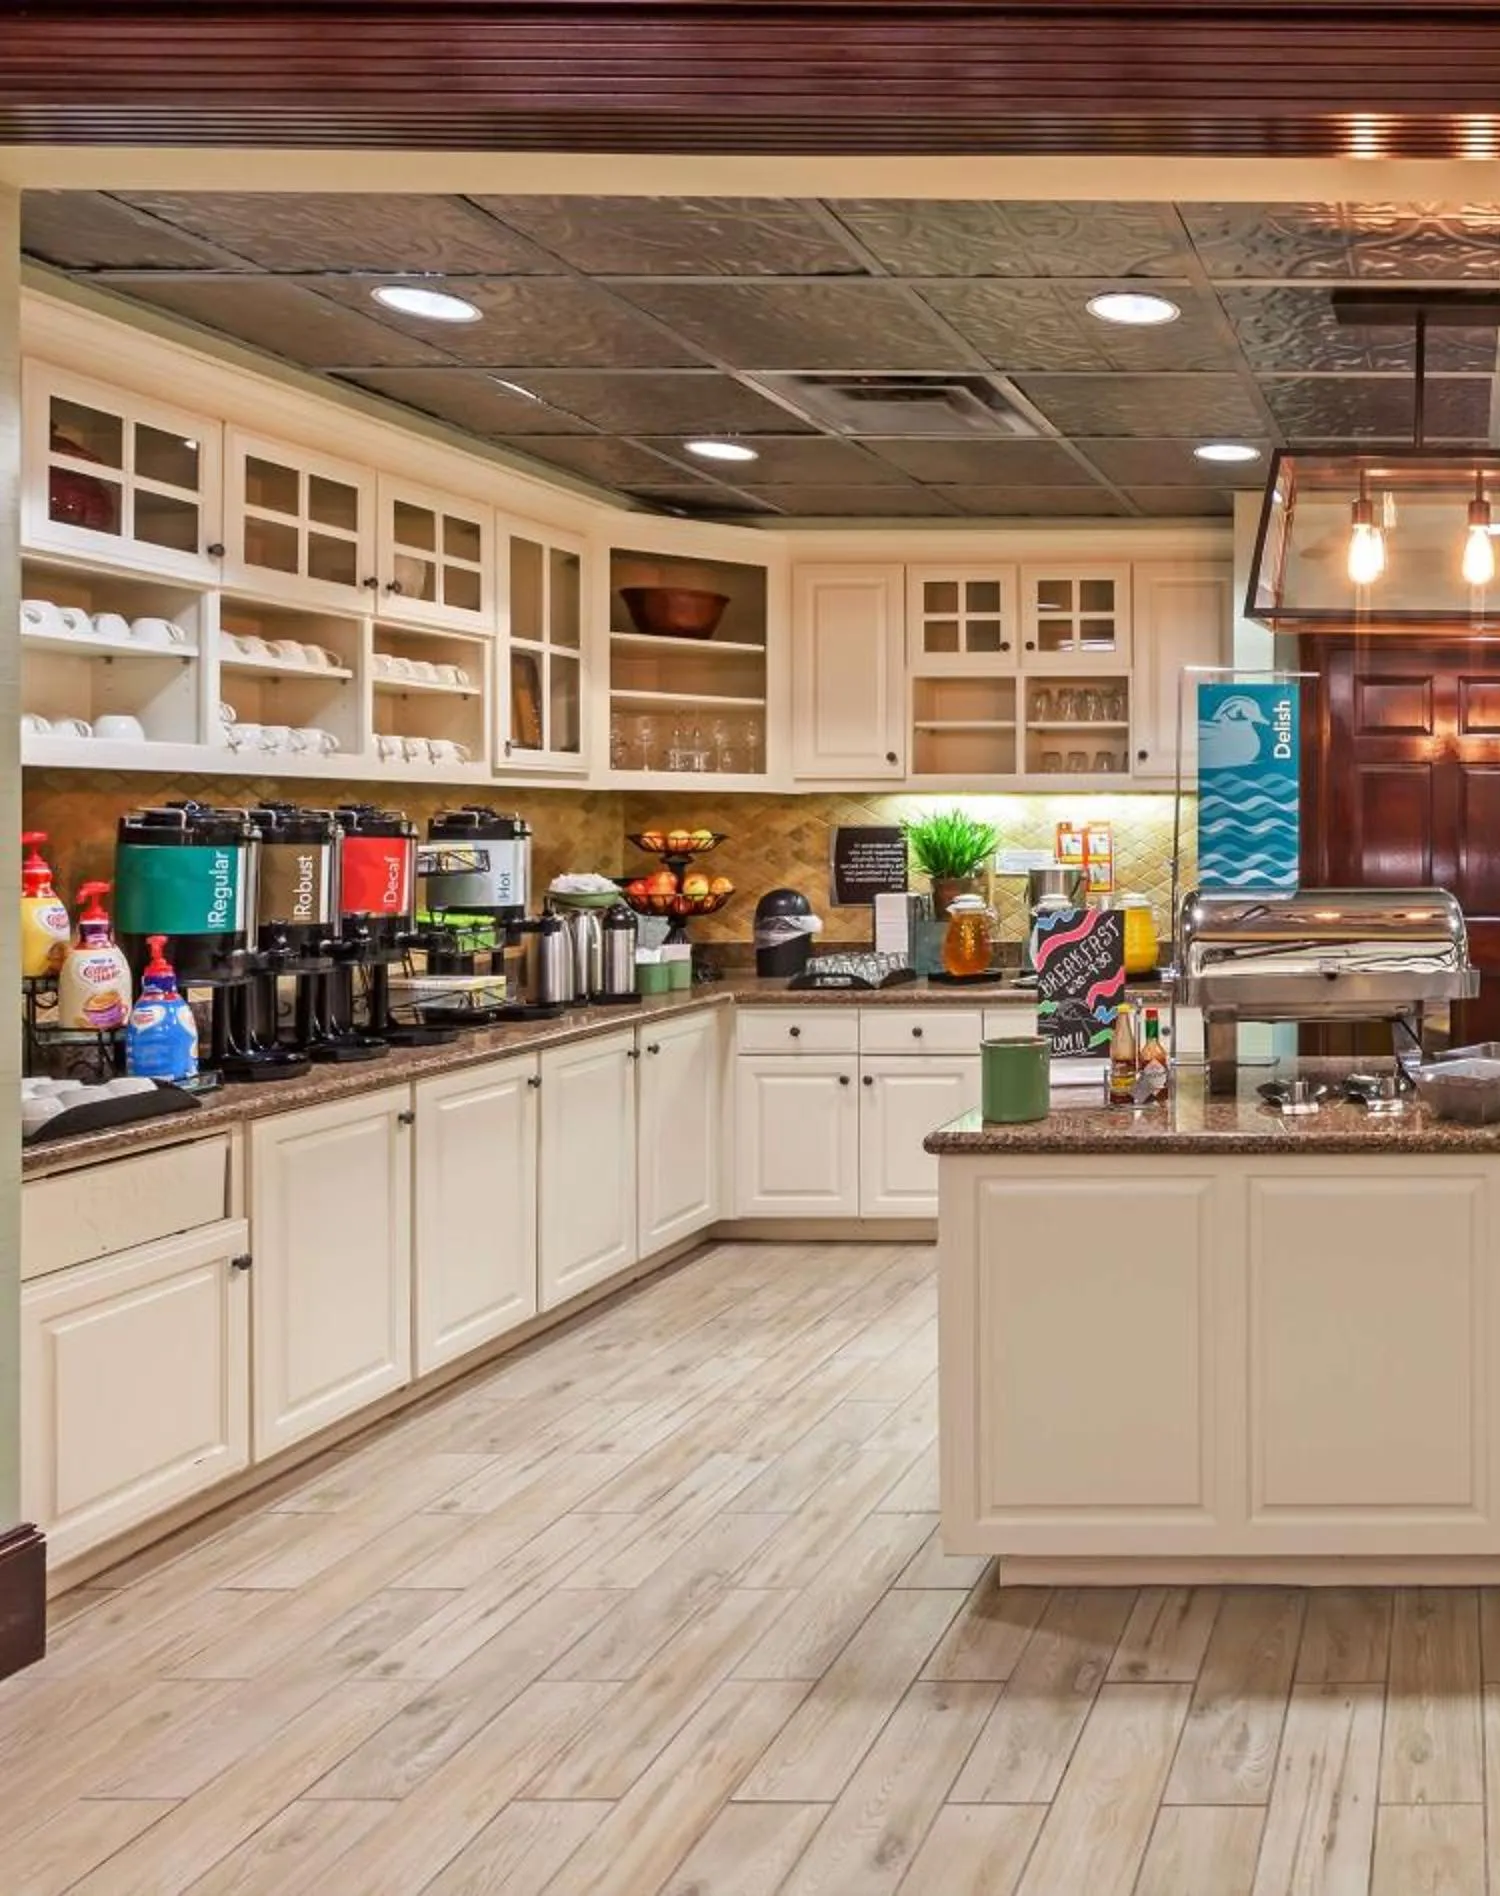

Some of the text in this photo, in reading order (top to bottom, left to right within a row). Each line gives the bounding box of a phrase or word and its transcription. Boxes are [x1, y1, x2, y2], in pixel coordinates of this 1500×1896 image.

[1272, 700, 1291, 759] Delish
[207, 849, 233, 923] Regular
[292, 855, 313, 915] Robust
[497, 872, 511, 899] Hot
[1038, 915, 1120, 998] BREAKFAST
